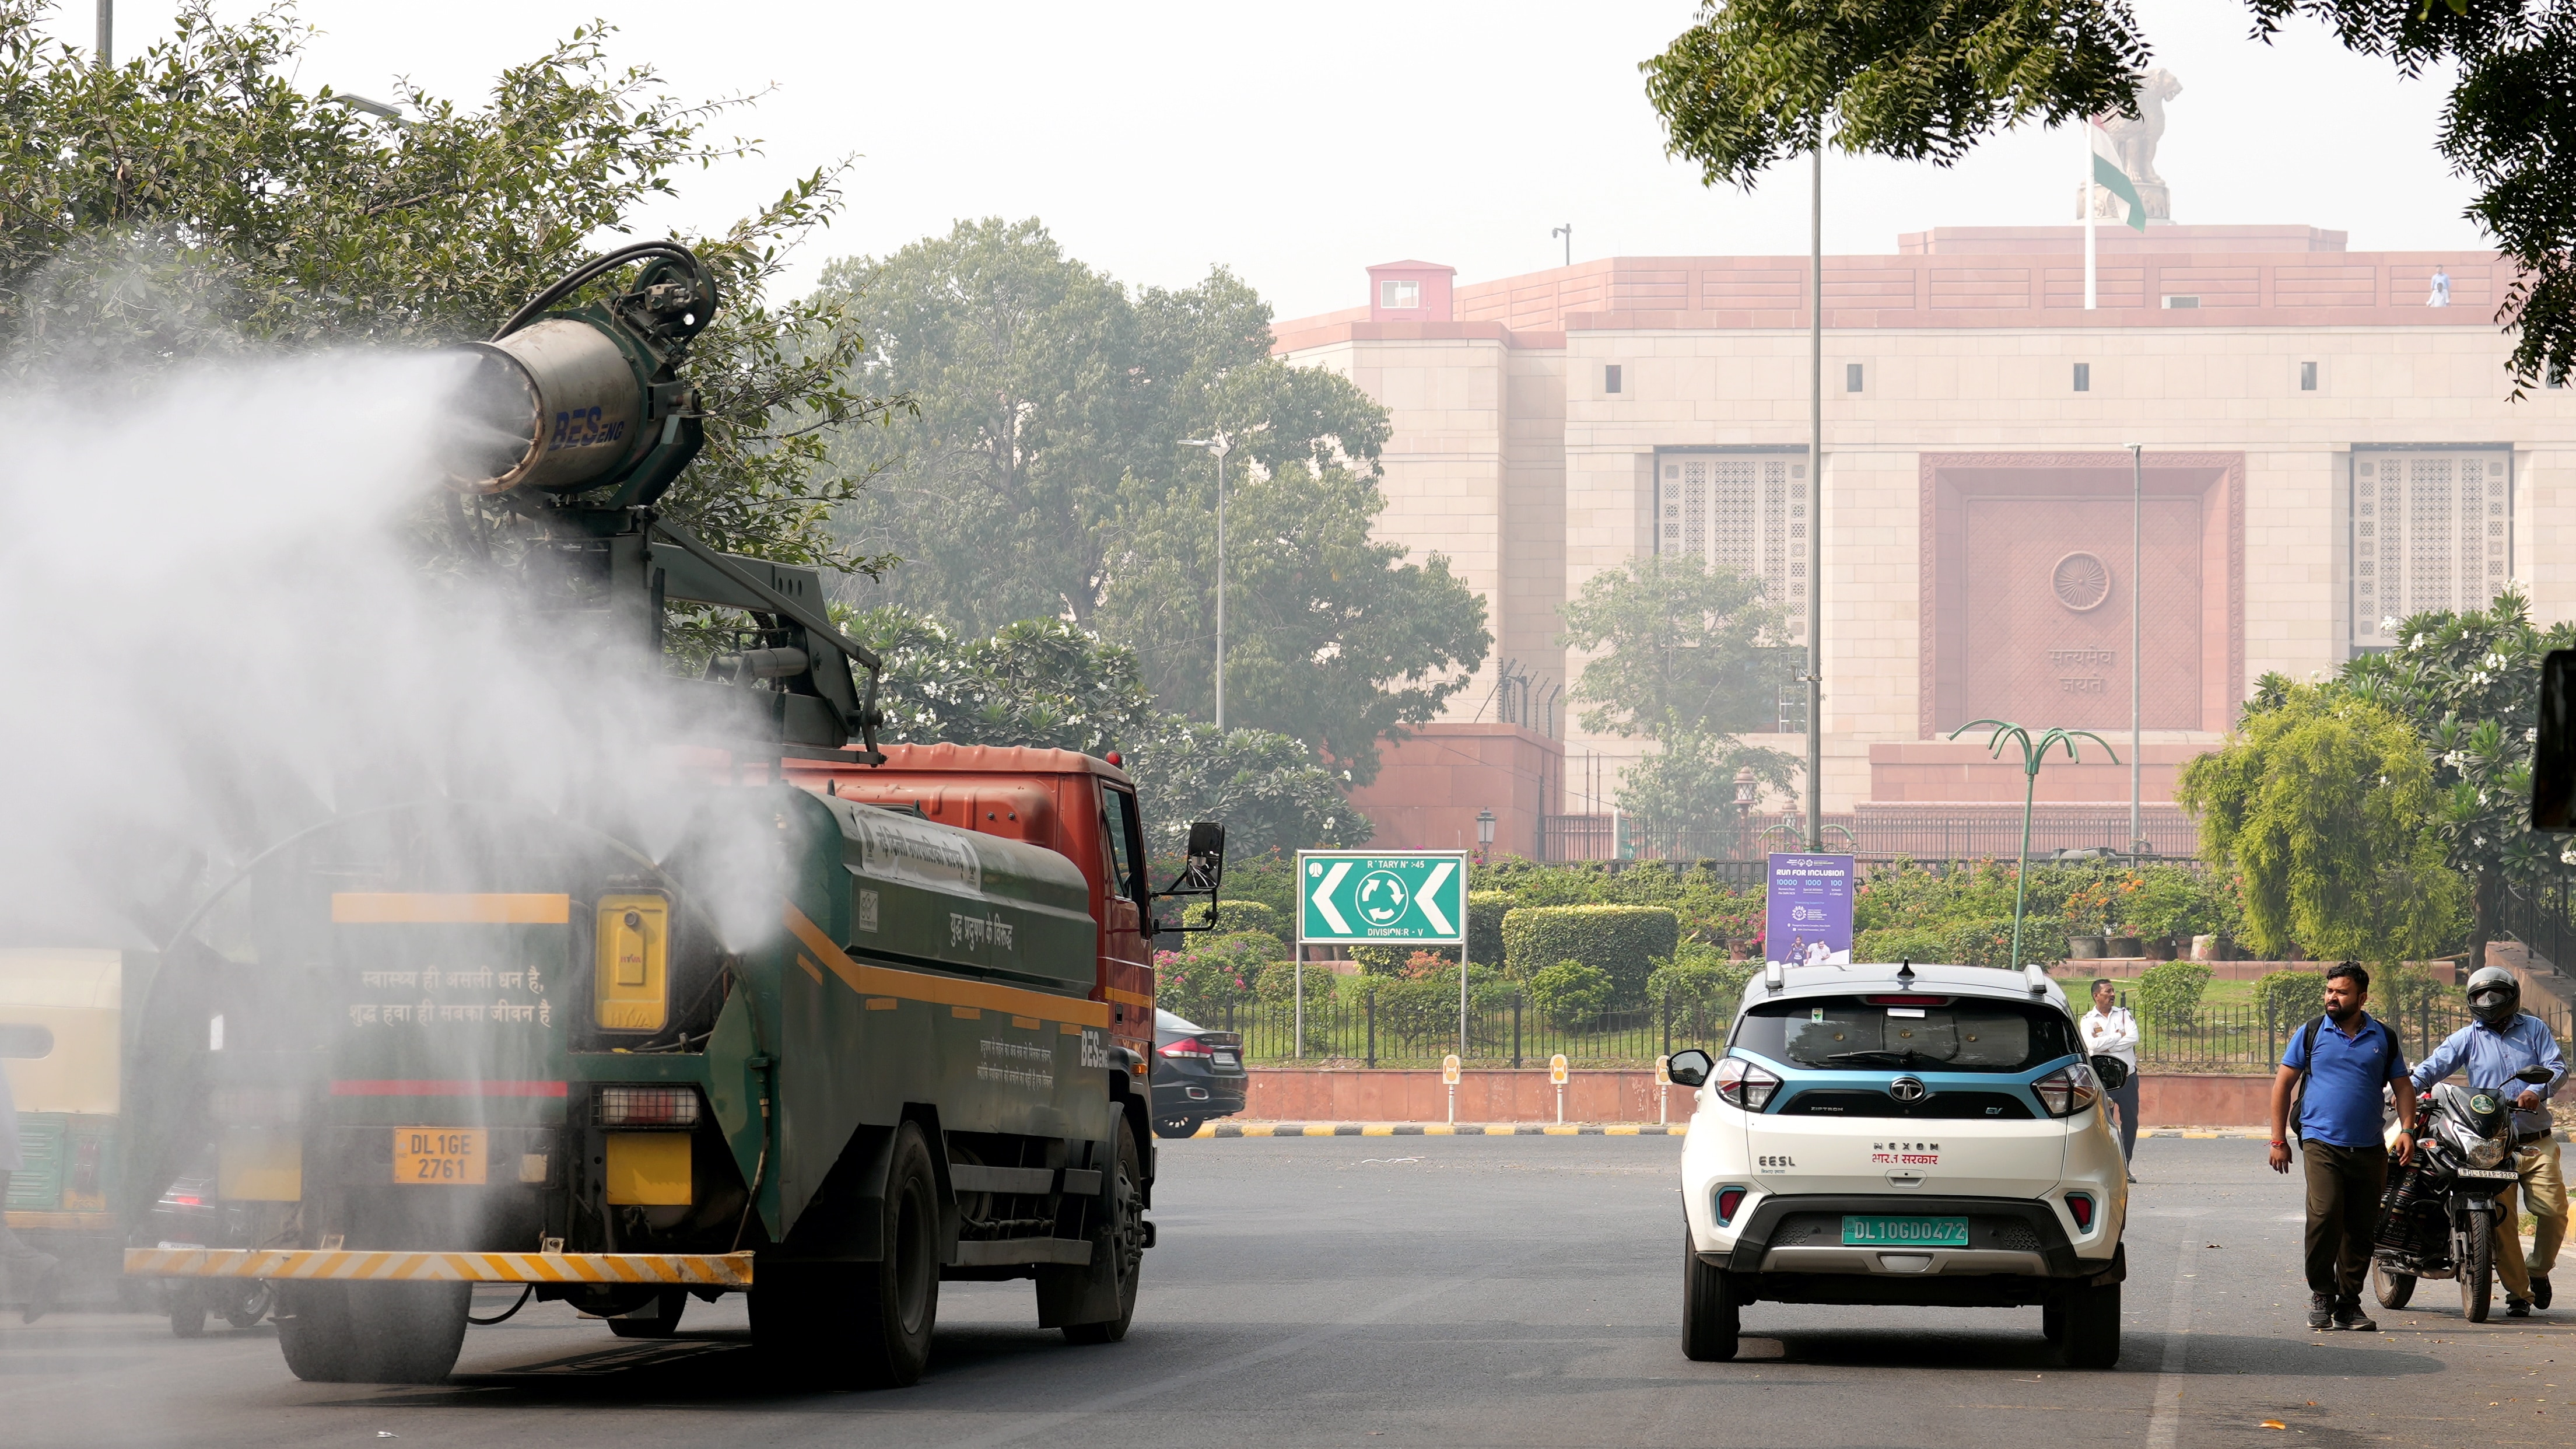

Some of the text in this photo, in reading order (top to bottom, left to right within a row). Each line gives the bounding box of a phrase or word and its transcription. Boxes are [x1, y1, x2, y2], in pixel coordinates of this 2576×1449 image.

[1367, 860, 1399, 869] RTARY
[1400, 860, 1409, 869] N
[949, 912, 963, 947] युद्ध
[986, 912, 993, 944] के
[621, 954, 641, 963] HYVA
[422, 965, 441, 994] ही
[446, 965, 493, 988] असली
[499, 972, 524, 989] धन
[349, 998, 552, 1028] शुद्ध हवा ही सबका जीवन है
[1873, 1142, 1939, 1151] NEXON
[1759, 1156, 1796, 1167] EESL
[1901, 1154, 1939, 1165] सरकार
[418, 1158, 465, 1179] 2761
